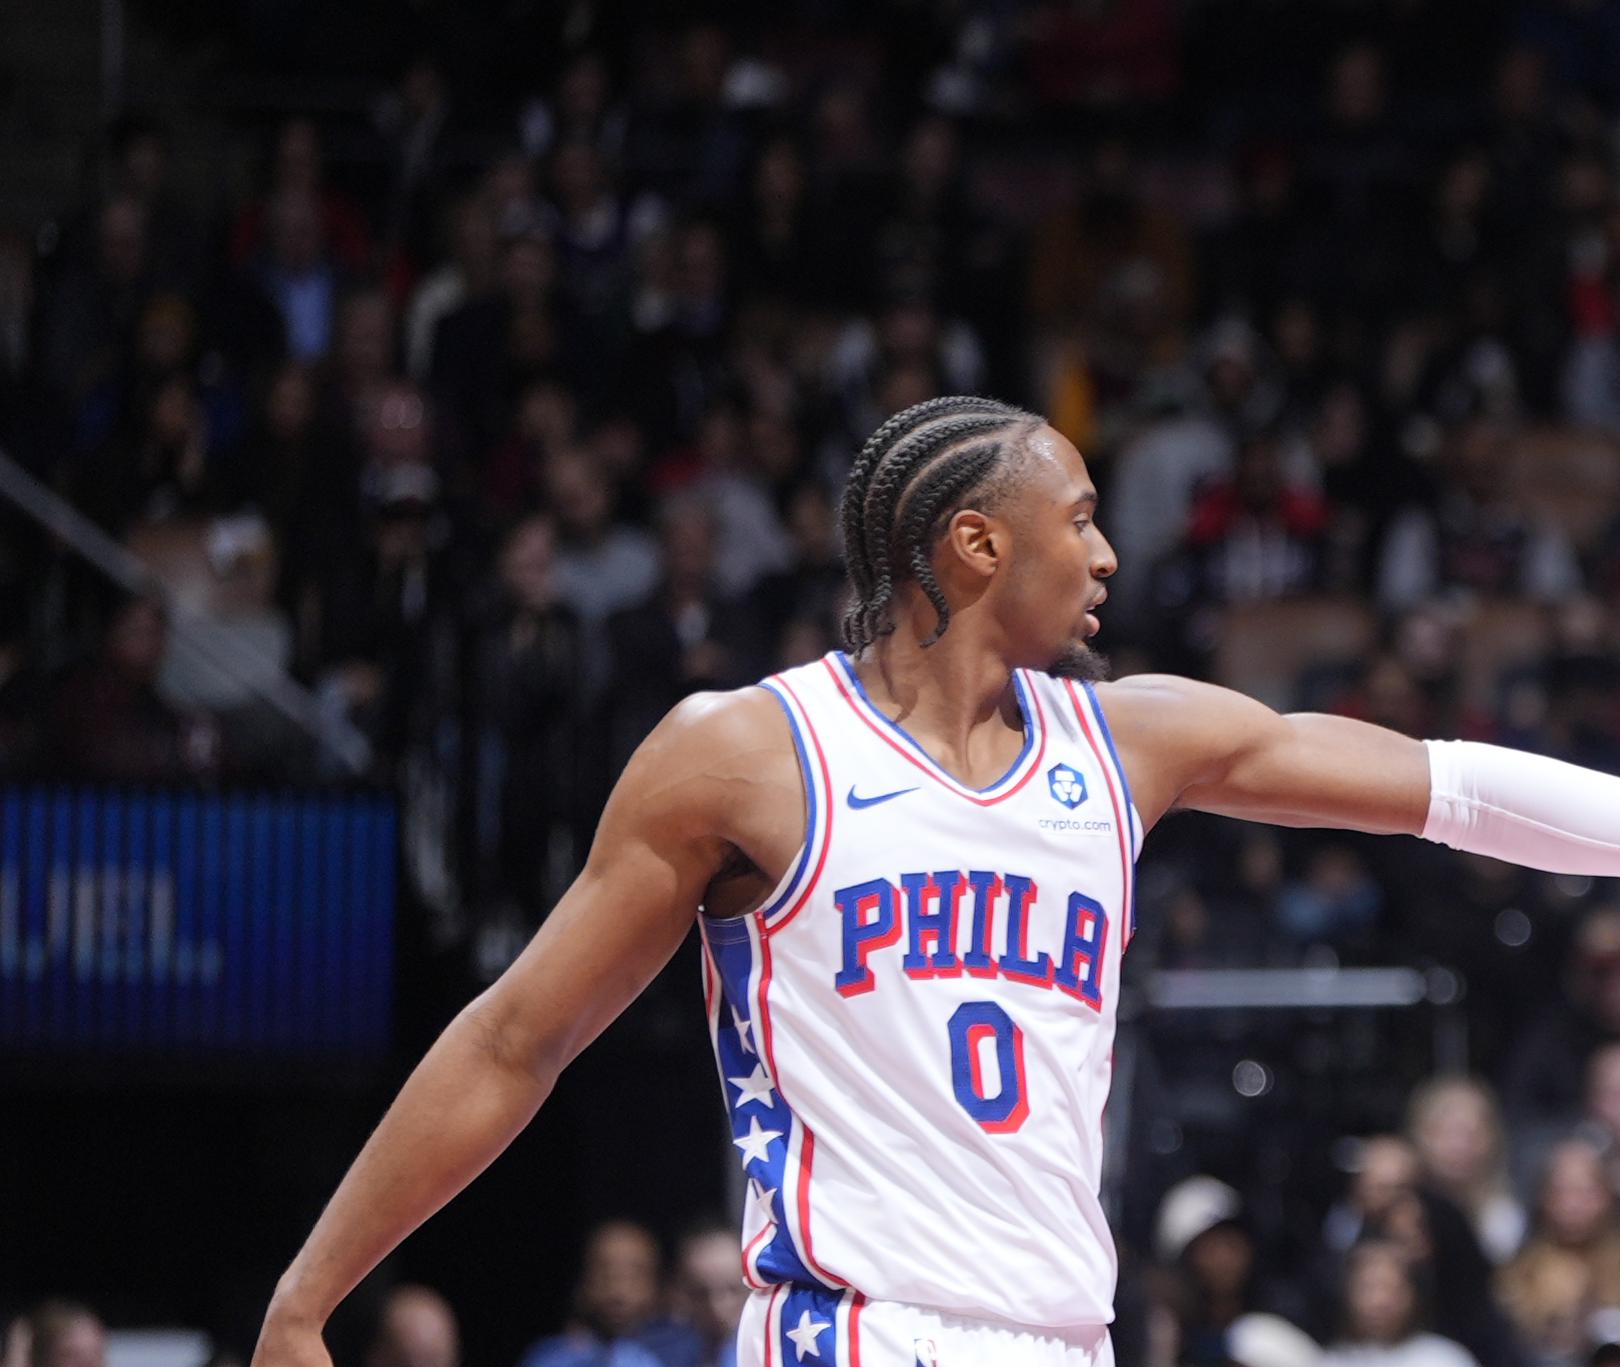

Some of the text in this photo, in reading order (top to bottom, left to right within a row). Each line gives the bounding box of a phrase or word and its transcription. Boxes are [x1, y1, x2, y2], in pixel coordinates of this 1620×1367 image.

[1038, 819, 1112, 832] crypto.com
[834, 869, 1109, 1014] PHILA
[947, 1001, 1029, 1134] 0
